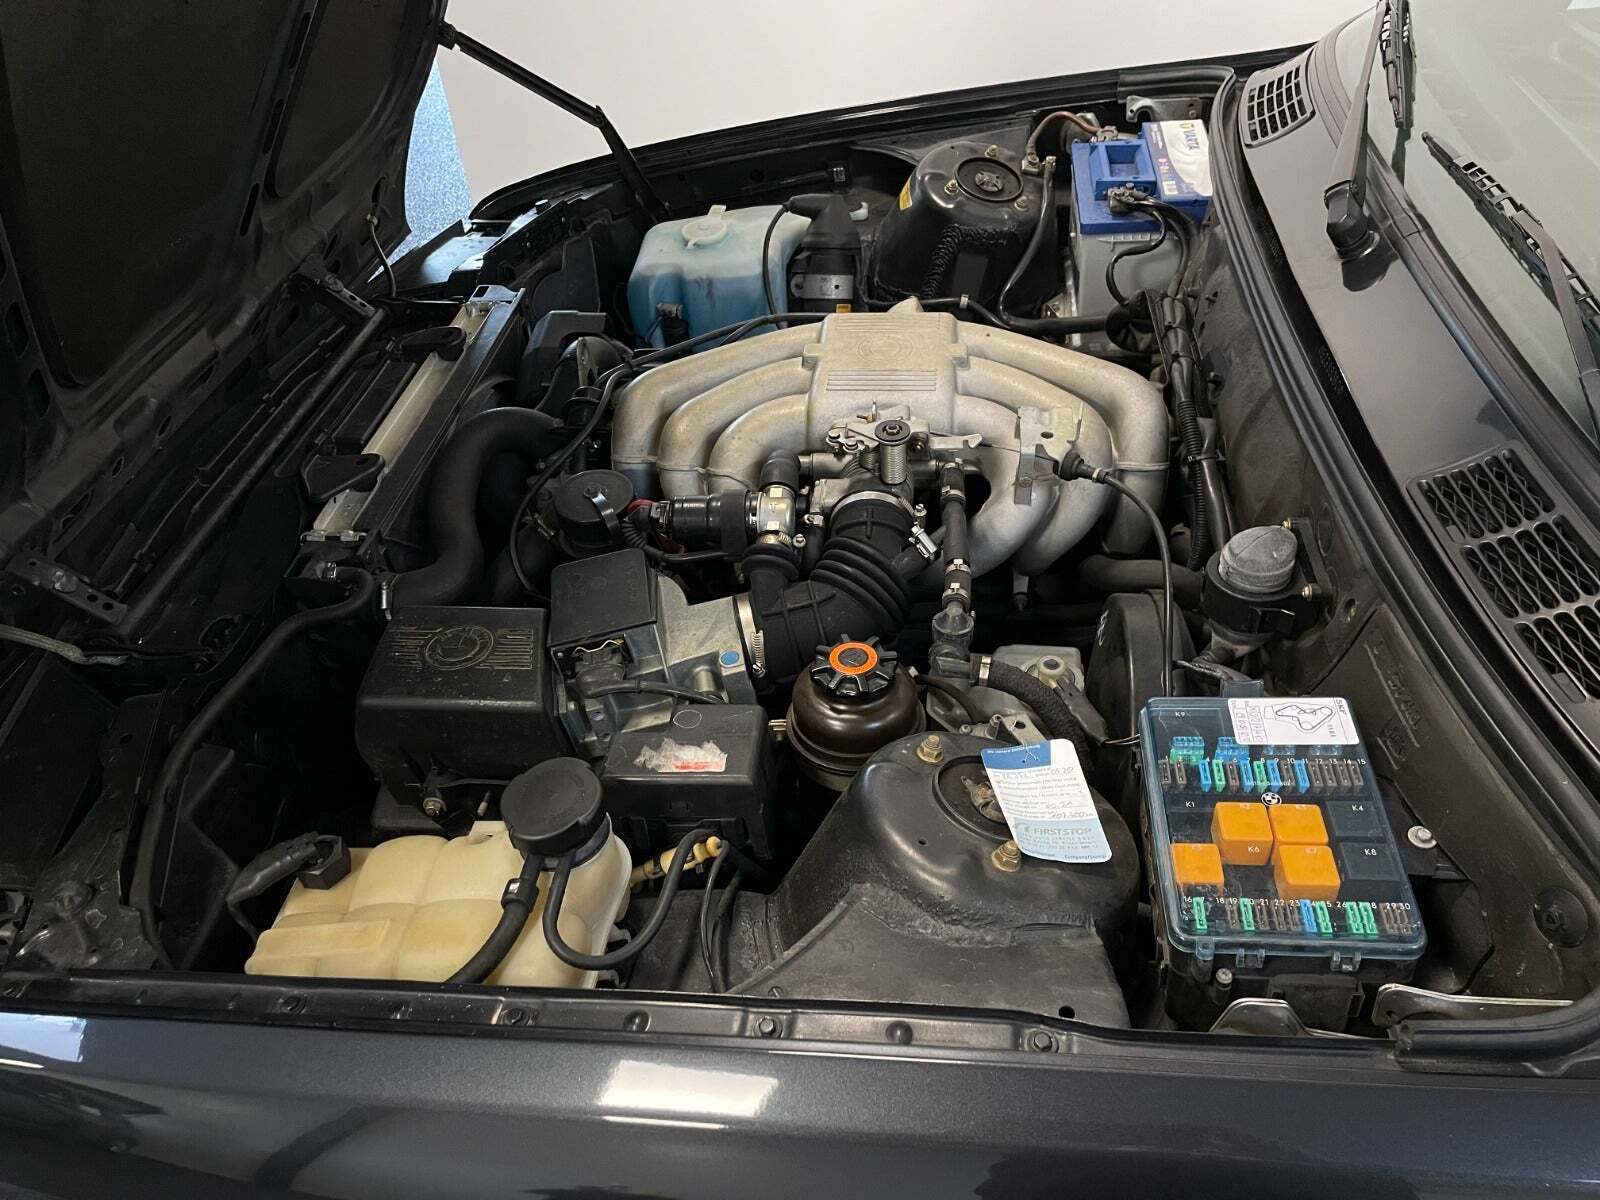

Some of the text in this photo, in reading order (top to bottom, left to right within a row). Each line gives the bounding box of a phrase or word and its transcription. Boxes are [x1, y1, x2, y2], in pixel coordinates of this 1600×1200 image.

[1184, 130, 1200, 150] VARTA
[1351, 804, 1364, 812] K4
[1247, 845, 1260, 853] K6
[1364, 848, 1377, 856] K8
[1260, 898, 1269, 906] 21
[1290, 899, 1300, 907] 23
[1386, 902, 1397, 910] 29
[1400, 902, 1411, 910] 30
